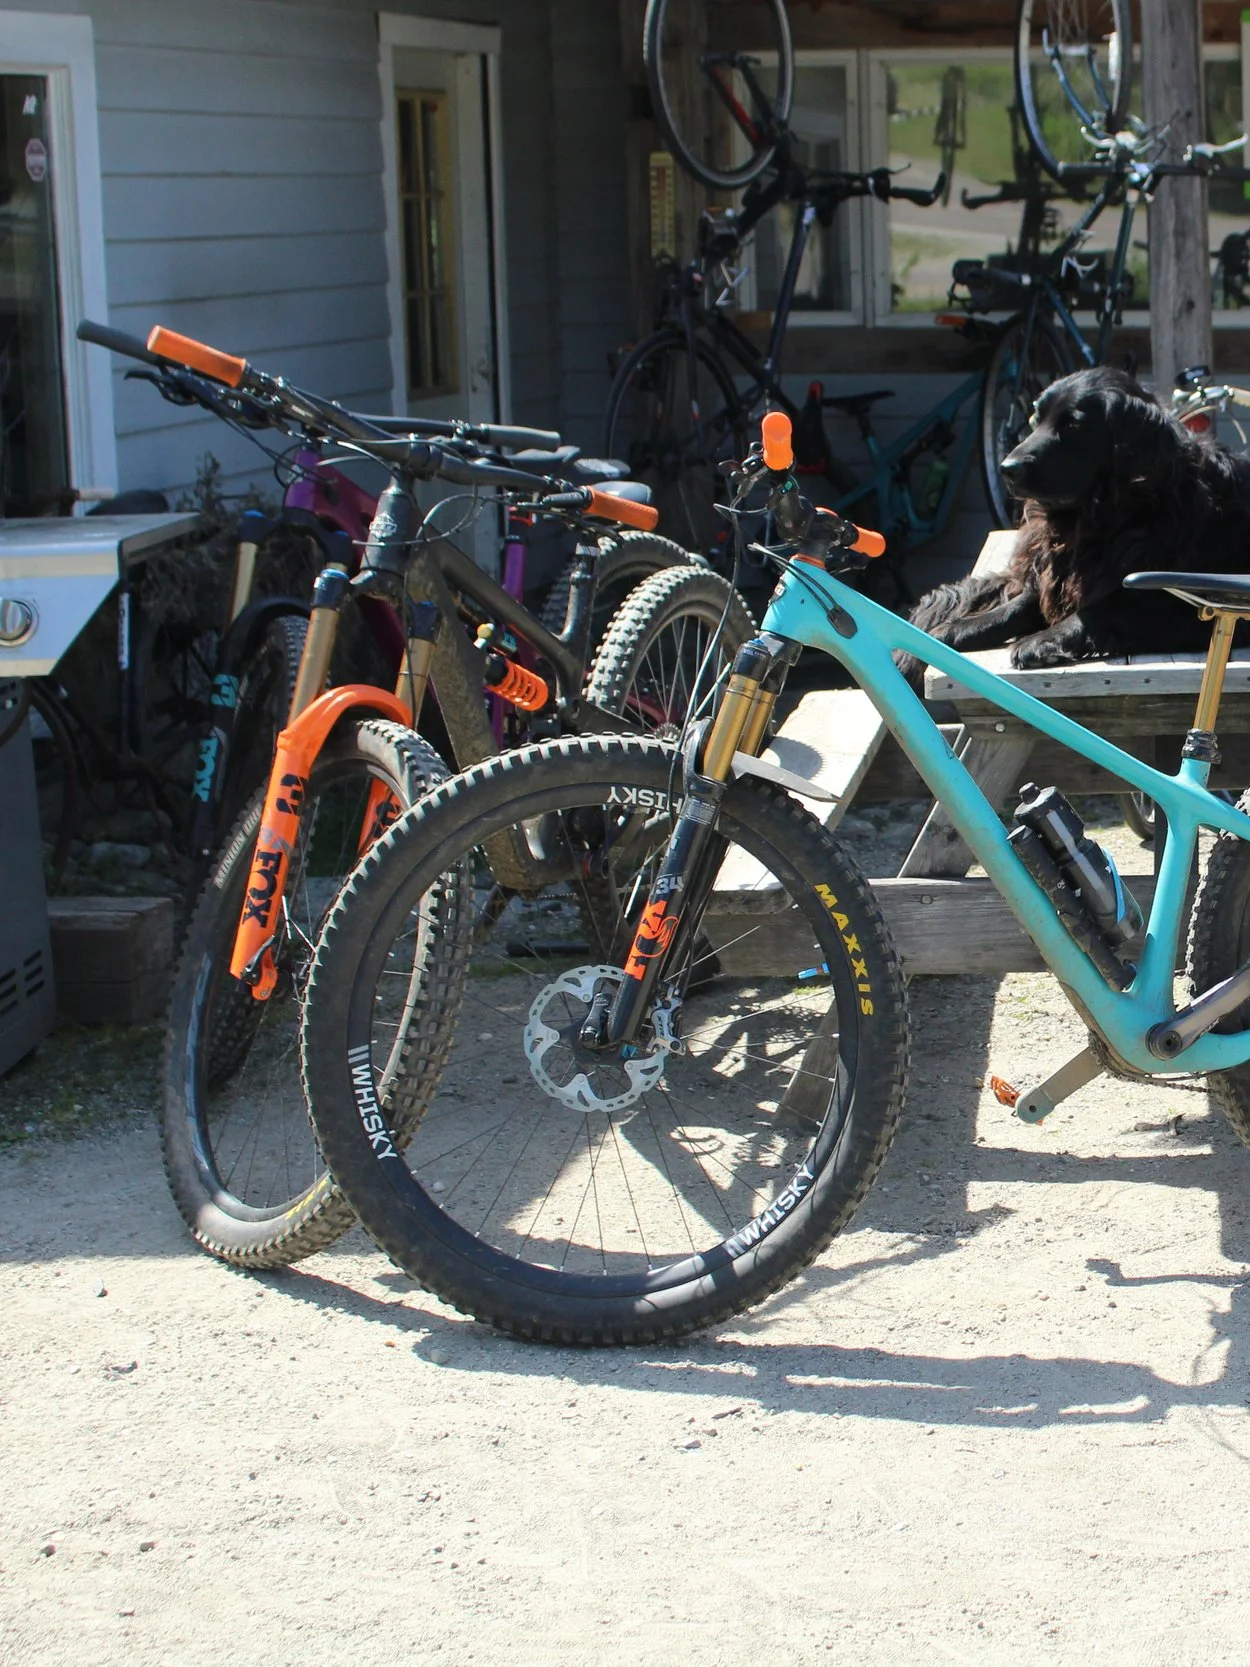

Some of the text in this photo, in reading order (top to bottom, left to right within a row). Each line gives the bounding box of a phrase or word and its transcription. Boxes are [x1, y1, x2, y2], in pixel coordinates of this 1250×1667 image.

[607, 786, 683, 814] HISKY
[213, 829, 246, 890] MINION
[242, 849, 283, 928] FOX
[656, 876, 685, 895] 34
[624, 899, 679, 981] FOX
[814, 883, 874, 1016] MAXXIS
[351, 1063, 398, 1160] WHISKY
[738, 1162, 814, 1246] WHISKY
